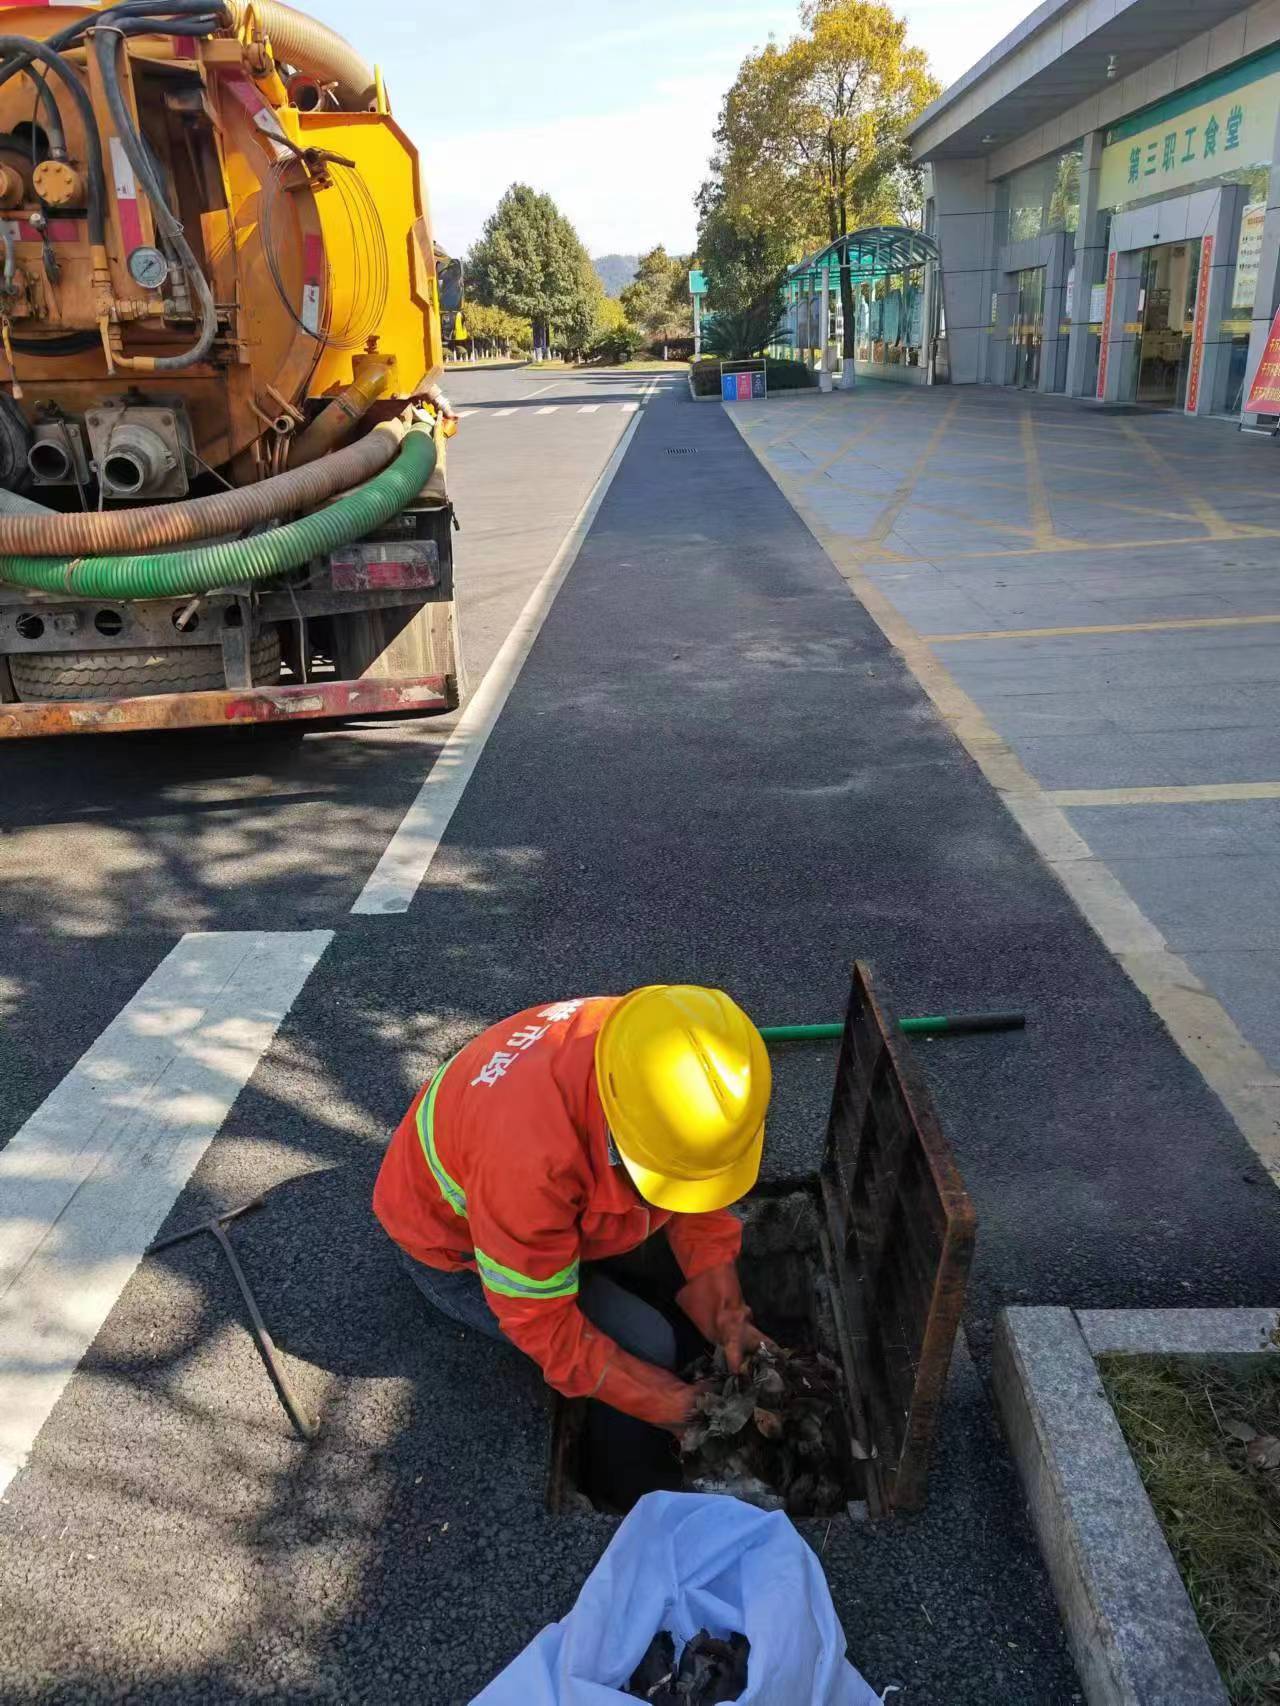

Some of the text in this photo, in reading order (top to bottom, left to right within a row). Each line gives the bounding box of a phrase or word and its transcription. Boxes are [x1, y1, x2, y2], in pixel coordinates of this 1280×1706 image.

[1128, 104, 1243, 184] 第三职工食堂
